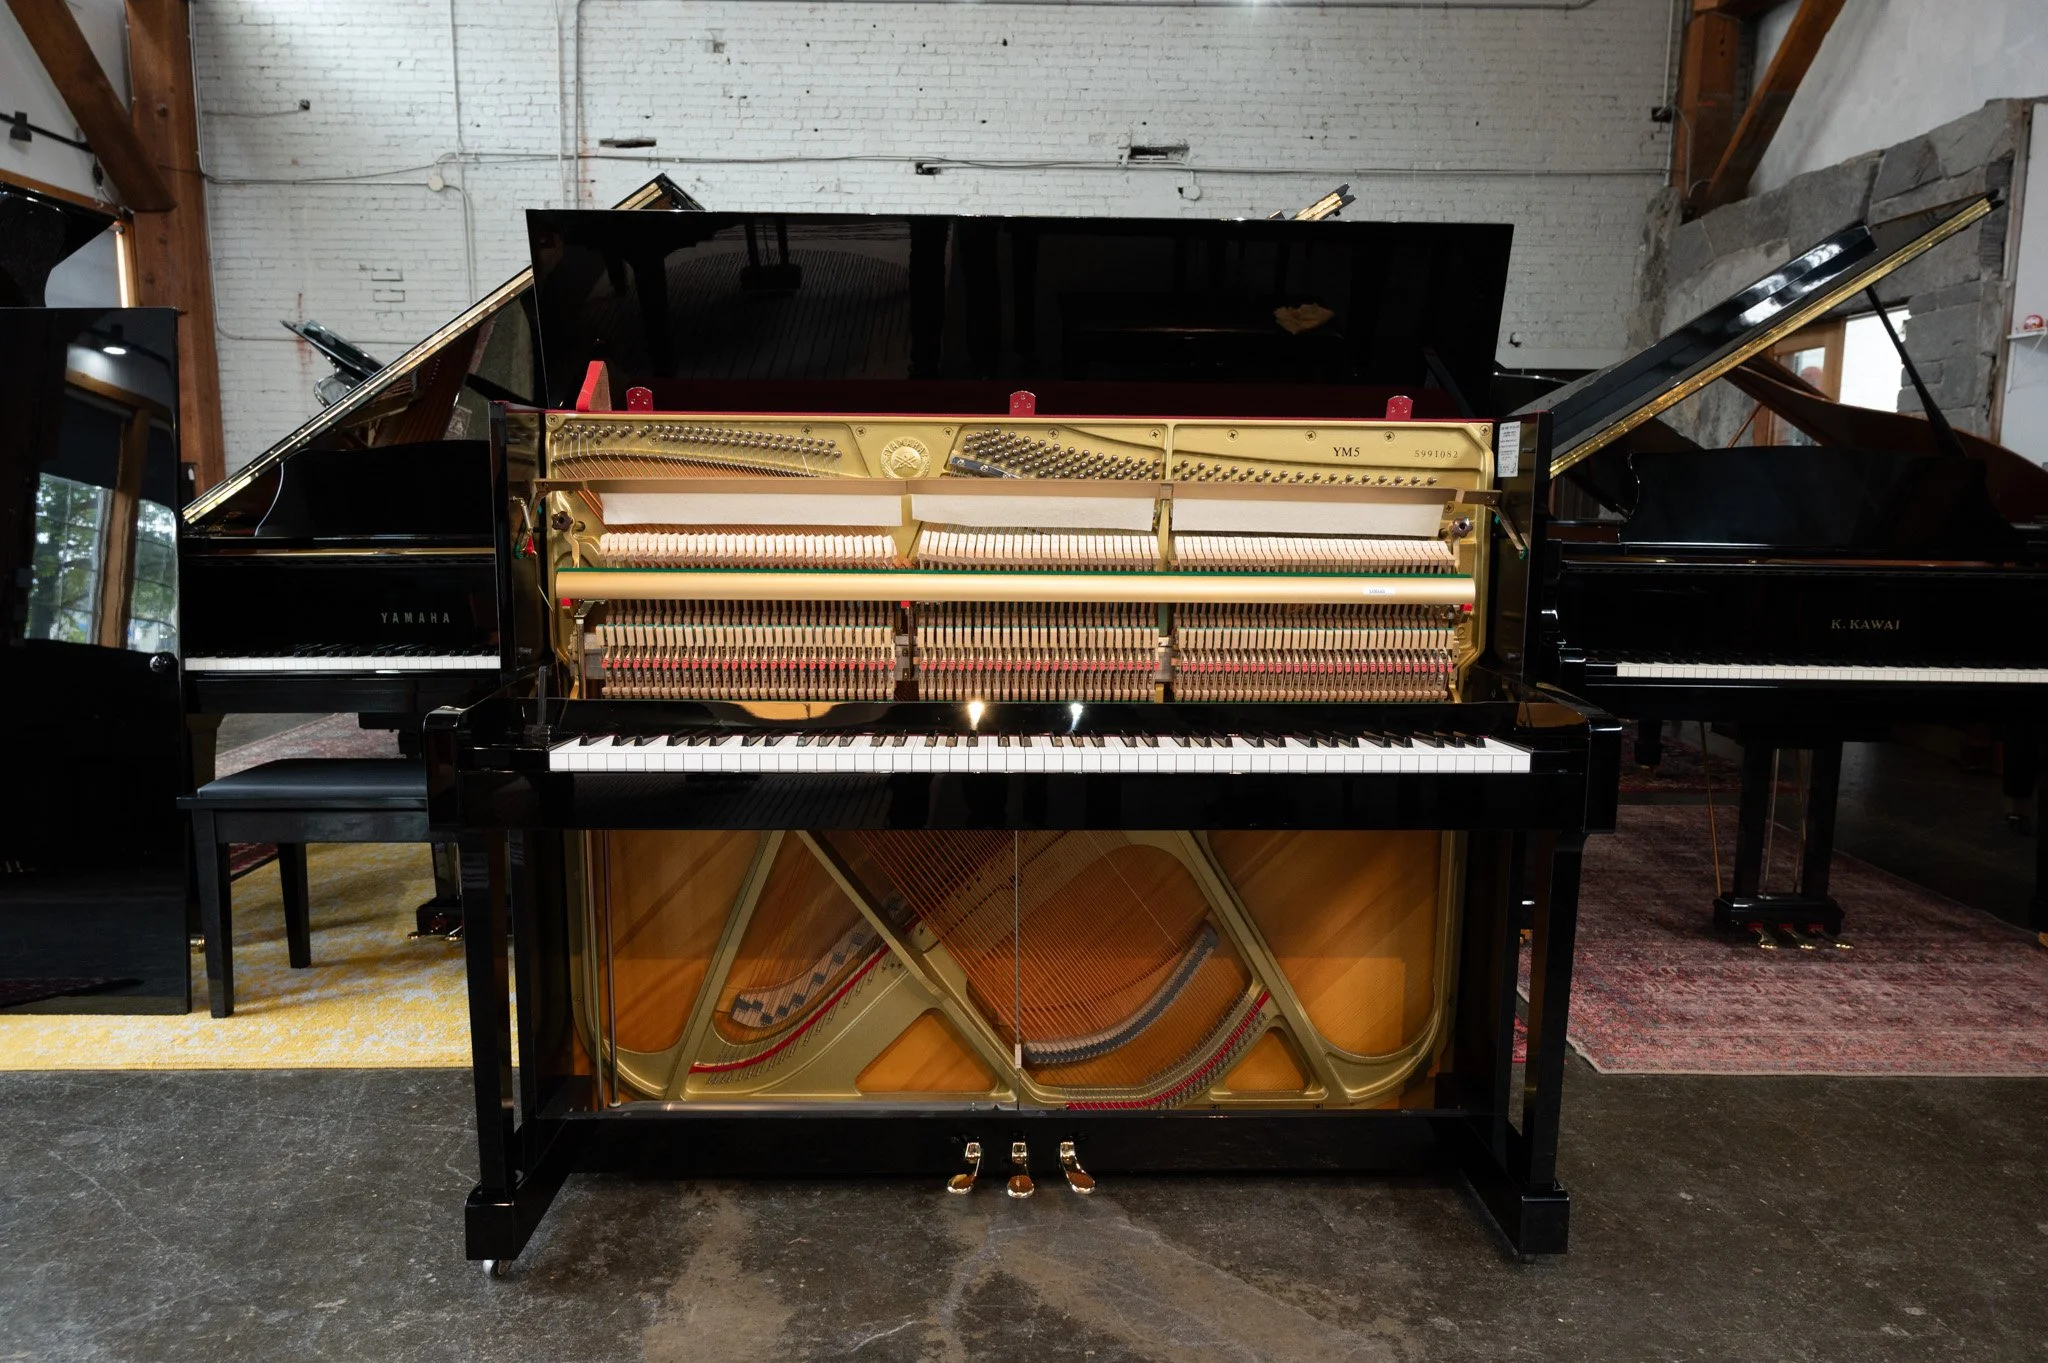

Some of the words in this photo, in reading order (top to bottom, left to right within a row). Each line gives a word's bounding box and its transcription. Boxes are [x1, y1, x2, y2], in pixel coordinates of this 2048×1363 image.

[1333, 447, 1360, 457] YM5
[1414, 450, 1458, 458] 5991082
[381, 612, 450, 624] YAMAHA
[1831, 619, 1846, 629] K.
[1850, 619, 1901, 630] KAWAI
